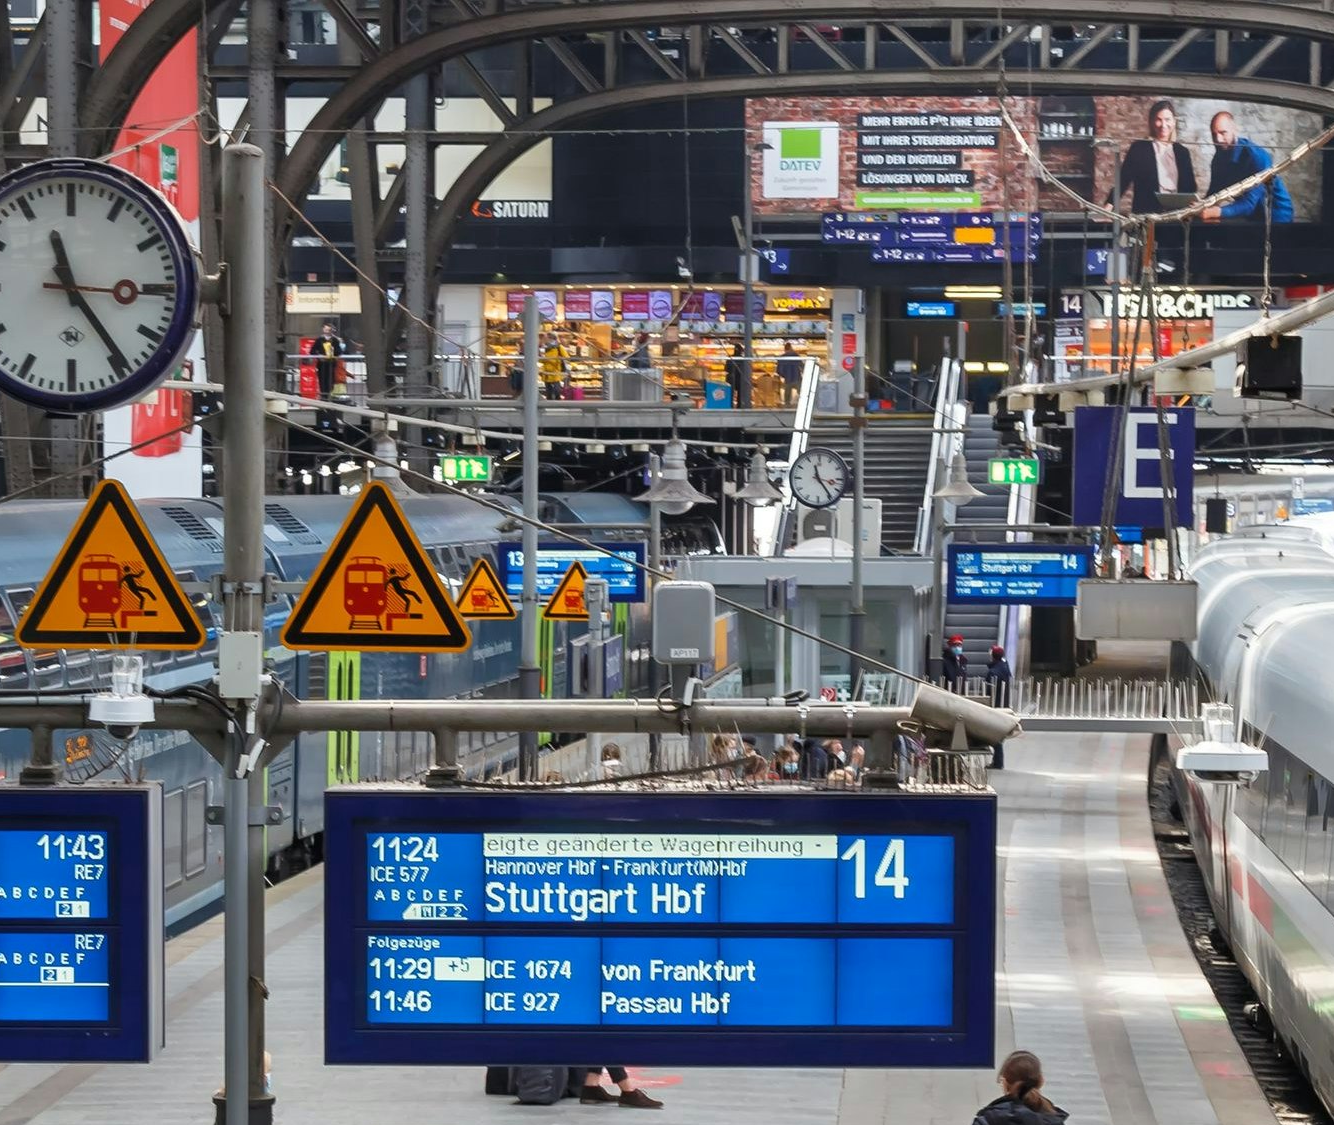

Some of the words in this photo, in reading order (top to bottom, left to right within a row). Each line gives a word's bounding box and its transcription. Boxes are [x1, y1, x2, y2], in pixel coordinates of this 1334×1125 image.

[862, 116, 891, 126] MEHR
[862, 136, 881, 145] MIT
[882, 136, 910, 146] IHRER
[911, 136, 995, 146] STEUERBERATUNG
[780, 161, 821, 171] DATEV
[862, 155, 884, 165] UND
[885, 155, 906, 165] DEN
[907, 155, 956, 165] DIGITALEN
[862, 172, 912, 184] LÖSUNGEN
[914, 174, 935, 184] VON
[937, 174, 969, 184] DATEV.
[493, 202, 549, 218] SATURN
[1061, 295, 1082, 313] 14
[1124, 413, 1178, 498] E
[1062, 554, 1078, 570] 14
[36, 833, 105, 860] 11:43
[372, 836, 439, 862] 11:24
[486, 837, 539, 853] eigte
[660, 836, 803, 856] Wagenreihung
[74, 864, 104, 880] RE7
[370, 866, 396, 882] ICE
[399, 866, 429, 882] 577
[485, 859, 562, 876] Hannover
[567, 860, 595, 876] Hbf
[613, 859, 747, 876] Frankfurt(M)Hbf
[841, 838, 909, 899] 14
[12, 886, 22, 899] B
[28, 886, 38, 899] C
[44, 886, 55, 899] D
[60, 886, 69, 899] E
[76, 886, 85, 899] F
[374, 889, 386, 901] A
[391, 889, 401, 901] B
[407, 889, 416, 901] C
[423, 889, 433, 901] D
[439, 889, 448, 901] E
[455, 889, 464, 901] F
[61, 905, 71, 915] 2
[484, 883, 638, 921] Stuttgart
[651, 885, 706, 914] Hbf
[74, 934, 105, 950] RE7
[368, 936, 440, 951] Folgezüge
[13, 953, 23, 965] B
[29, 953, 38, 965] C
[45, 953, 55, 965] D
[61, 953, 70, 965] E
[77, 953, 85, 965] F
[45, 970, 55, 981] 2
[369, 958, 432, 980] 11:29
[485, 960, 516, 979] ICE
[524, 960, 572, 980] 1674
[602, 966, 641, 981] von
[651, 960, 756, 981] Frankfurt
[369, 990, 432, 1013] 11:46
[485, 993, 516, 1012] ICE
[522, 993, 560, 1012] 927
[601, 993, 683, 1014] Passau
[691, 993, 731, 1014] Hbf
